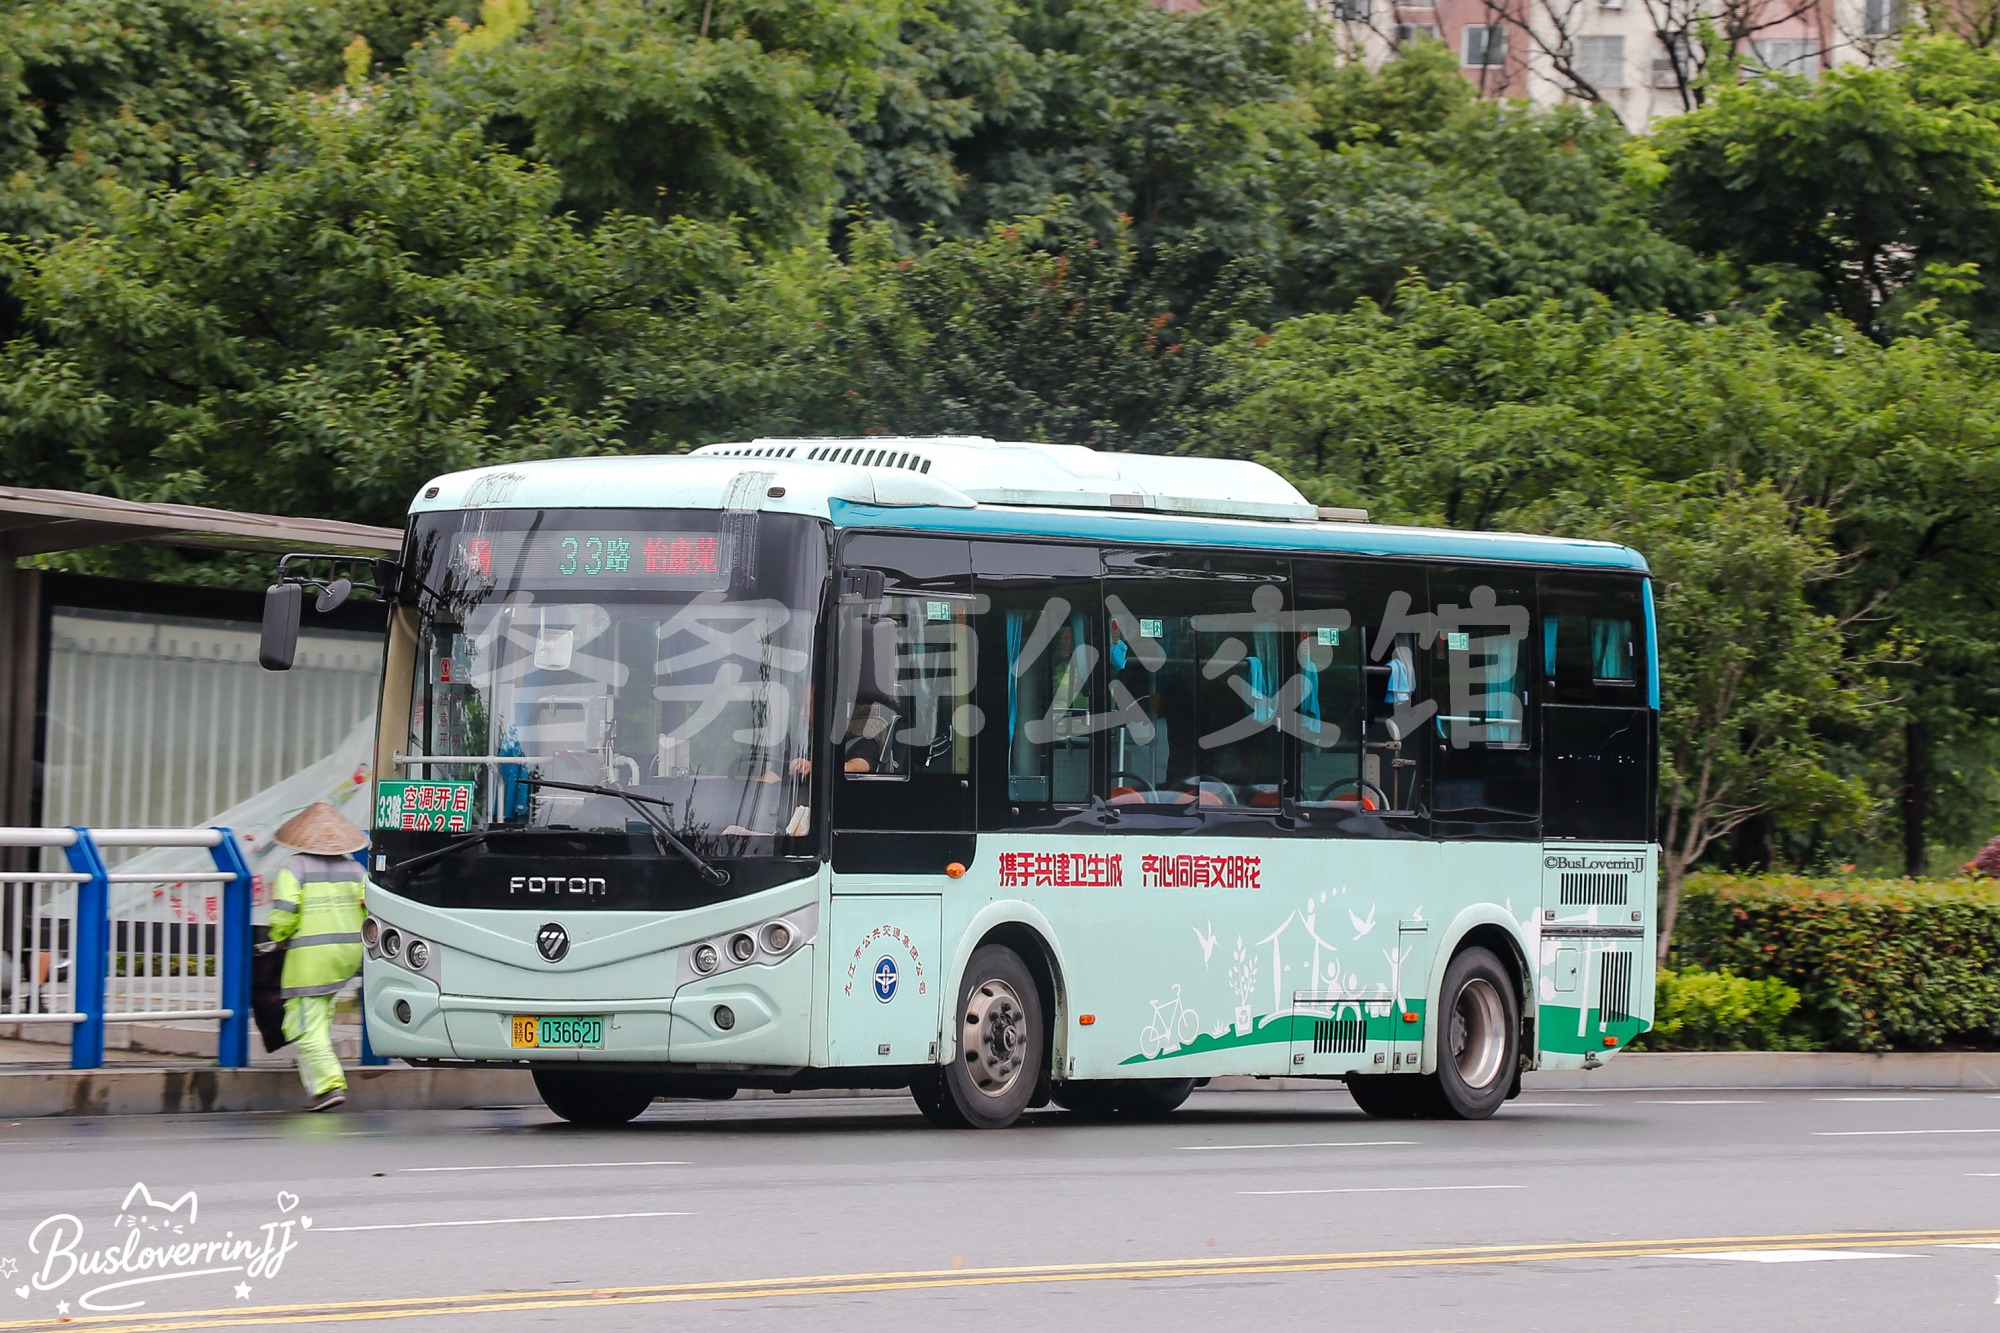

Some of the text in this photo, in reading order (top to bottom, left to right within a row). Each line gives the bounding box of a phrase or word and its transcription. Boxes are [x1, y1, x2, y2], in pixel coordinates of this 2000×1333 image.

[559, 537, 631, 575] 33路
[643, 537, 718, 575] 怡康苑
[377, 795, 402, 828] 33路
[402, 785, 470, 812] 空调开启
[509, 877, 606, 895] FOTON
[998, 852, 1261, 889] 携手共建卫生城 齐心同育文明花
